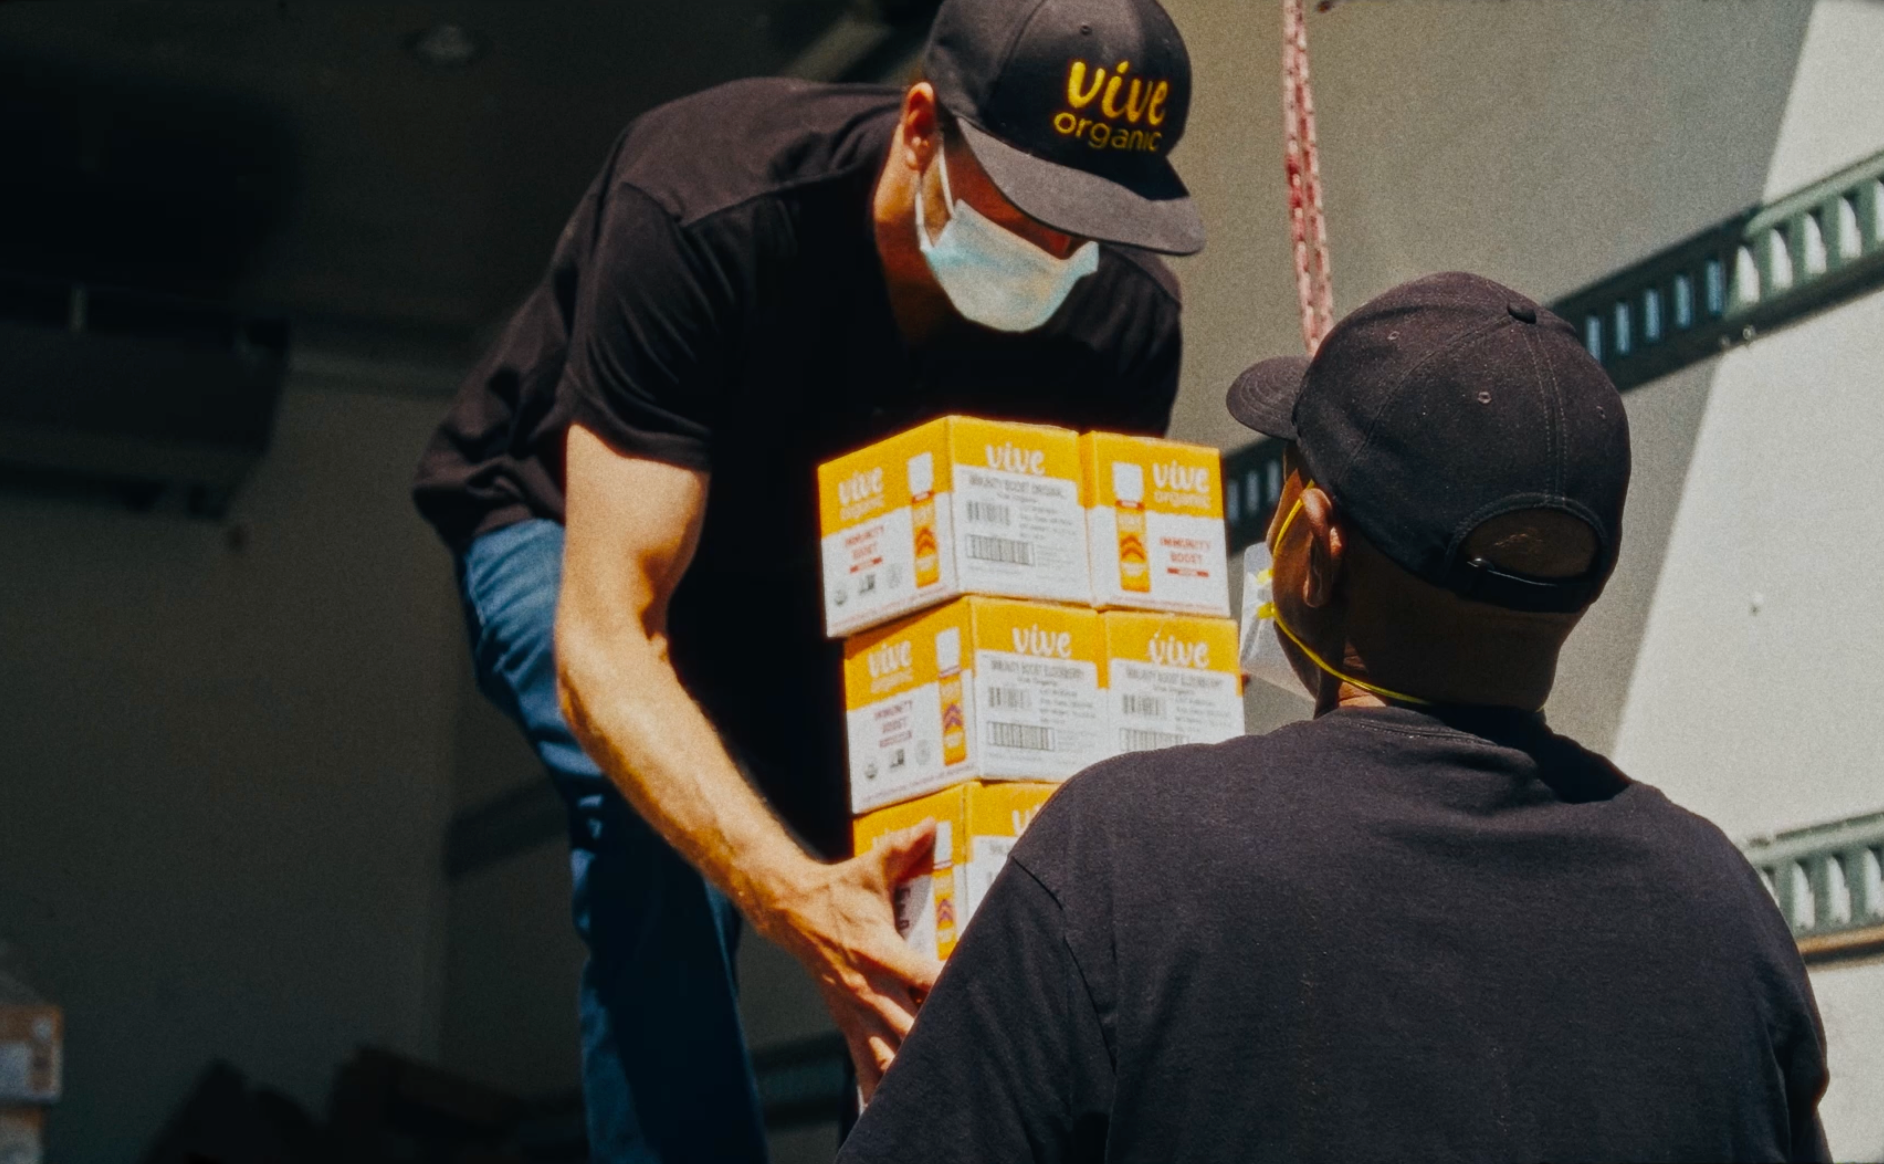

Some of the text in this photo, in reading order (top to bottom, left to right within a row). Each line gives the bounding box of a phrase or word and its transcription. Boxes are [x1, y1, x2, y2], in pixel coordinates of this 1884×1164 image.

[1068, 60, 1168, 126] vive
[1054, 112, 1162, 151] organic
[985, 441, 1046, 476] vive
[1152, 460, 1210, 493] vive
[1012, 623, 1072, 659] vive
[1148, 635, 1210, 670] vive
